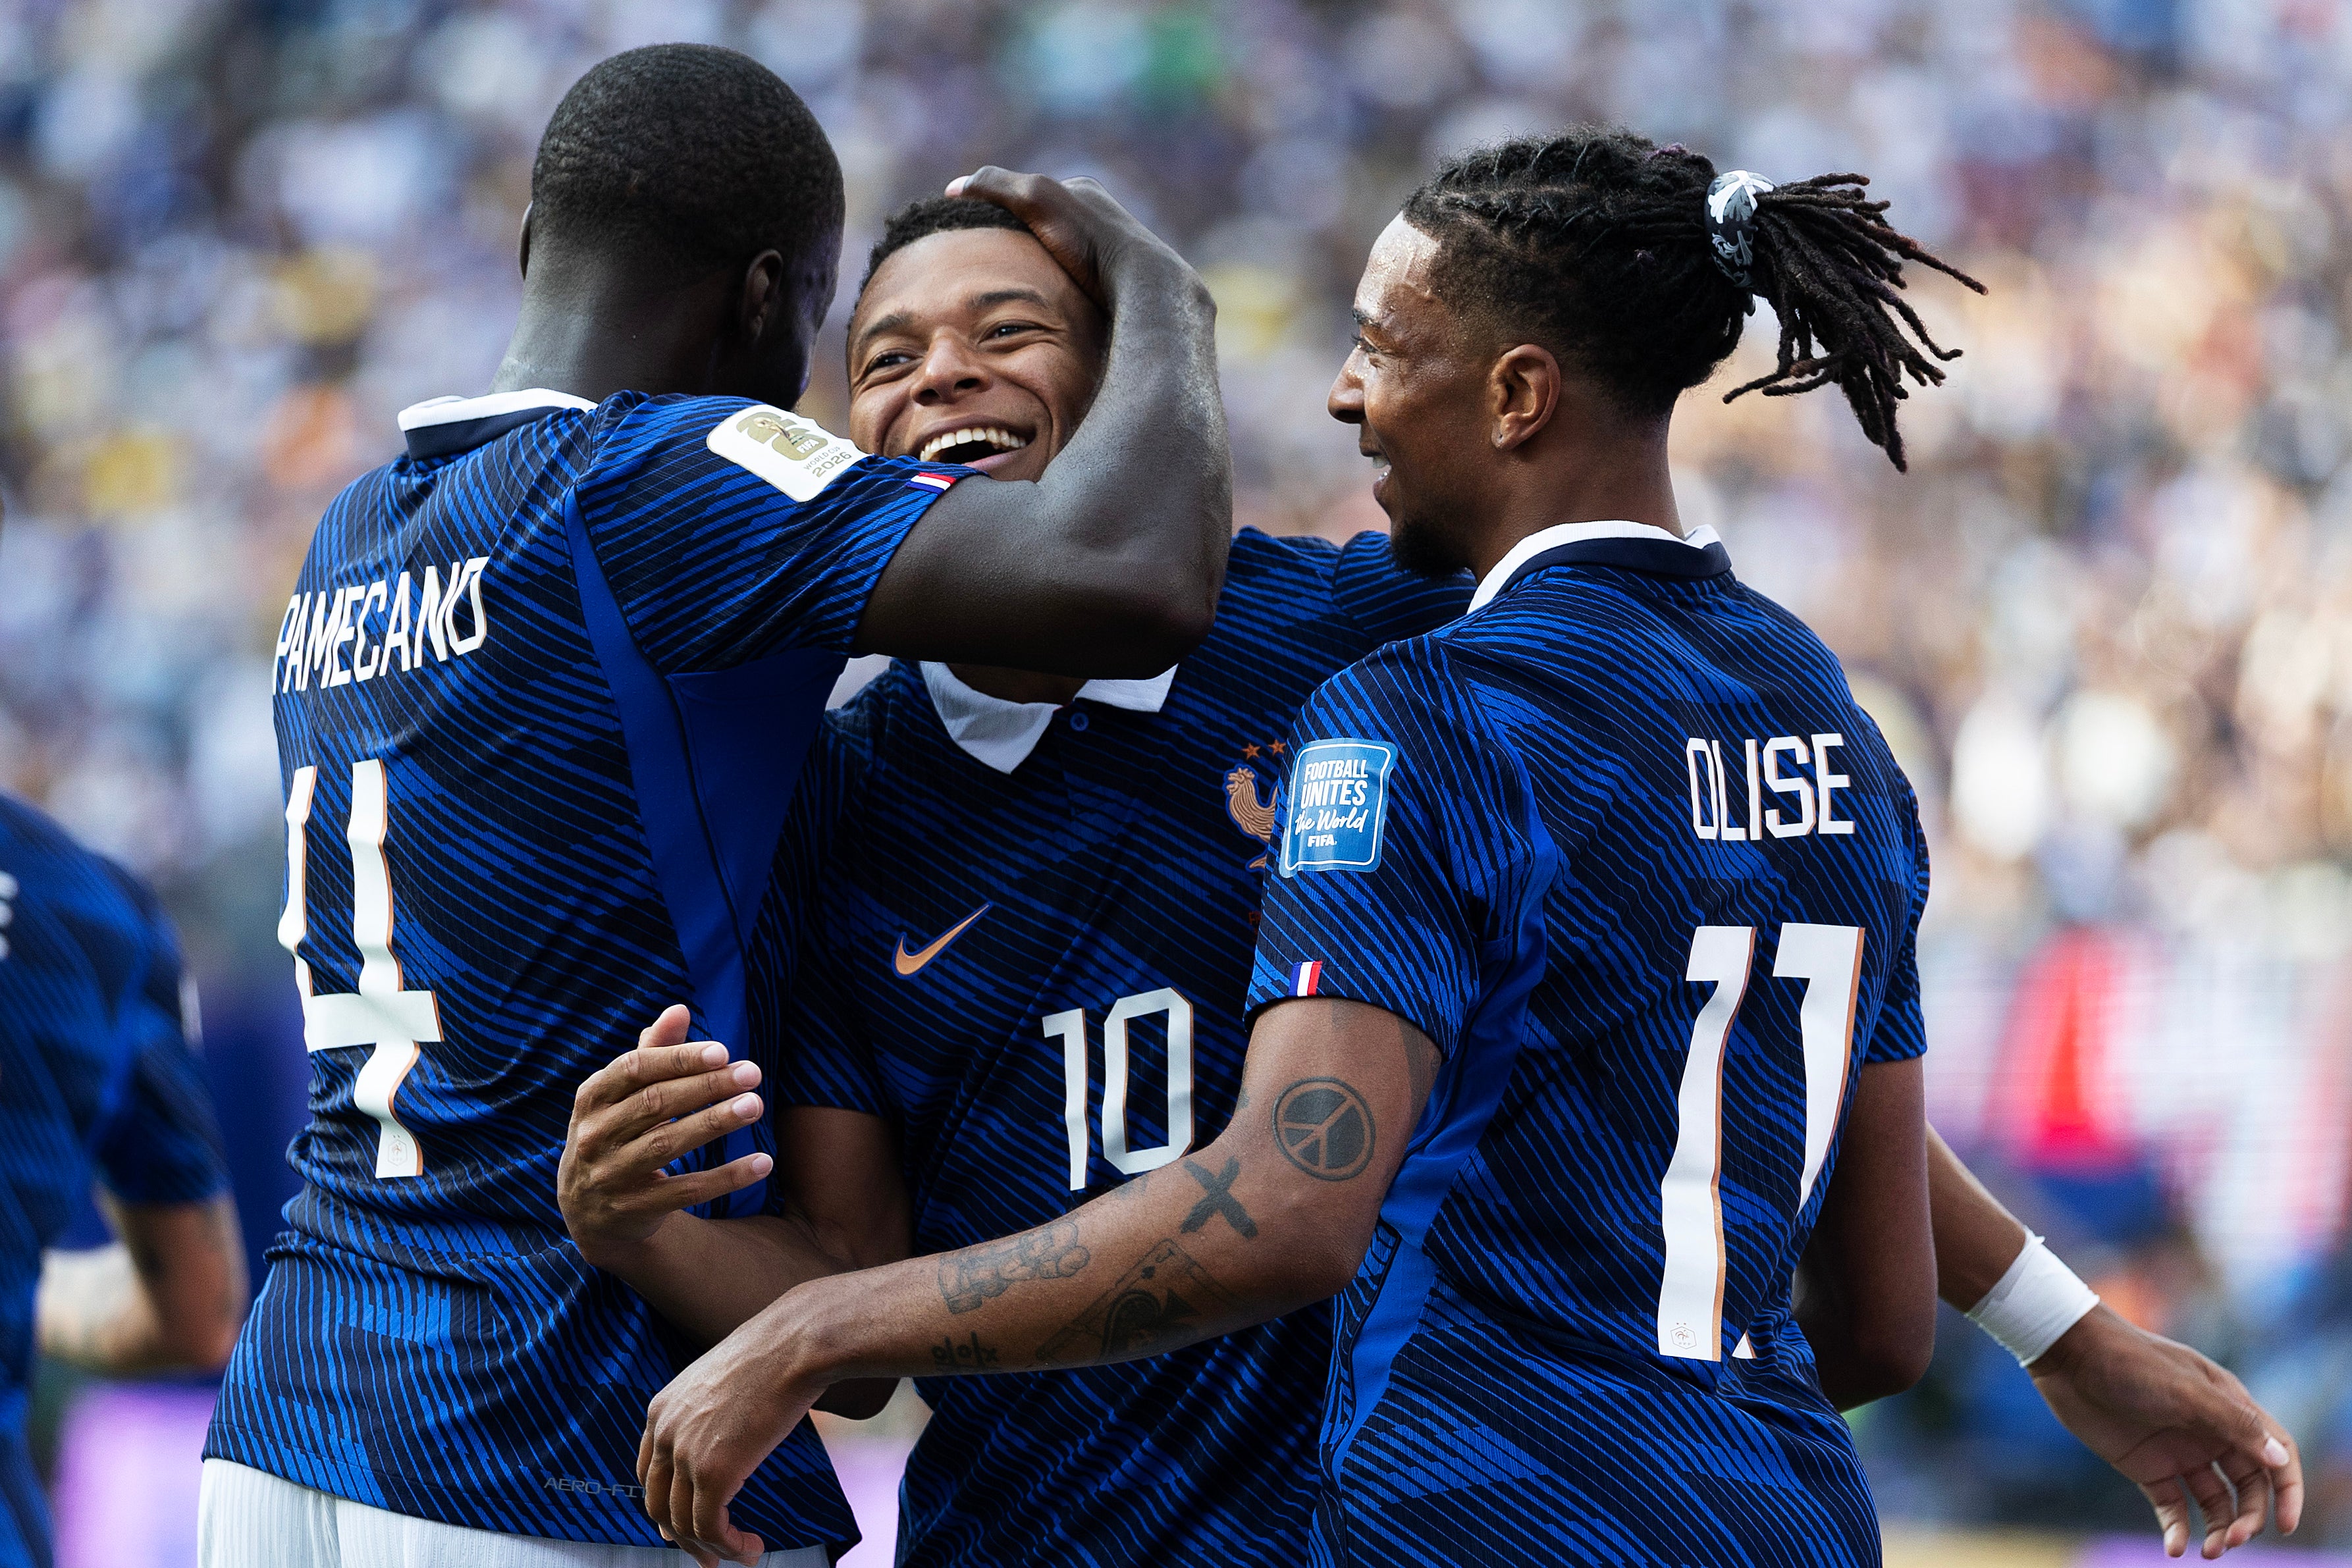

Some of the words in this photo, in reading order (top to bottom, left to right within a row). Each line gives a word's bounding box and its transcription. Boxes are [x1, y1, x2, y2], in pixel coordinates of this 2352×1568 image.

[795, 438, 820, 454] FIFA
[803, 452, 830, 471] WORLD
[827, 446, 841, 454] CUP
[812, 451, 853, 479] 2026
[272, 556, 490, 695] PAMECANO
[1304, 759, 1369, 783] FOOTBALL
[1300, 779, 1368, 810] UNITES
[1686, 733, 1856, 841] OLISE
[1295, 810, 1316, 836] the
[1316, 806, 1370, 833] World
[1307, 834, 1337, 848] FIFA
[277, 758, 445, 1178] 4
[1042, 987, 1195, 1191] 10
